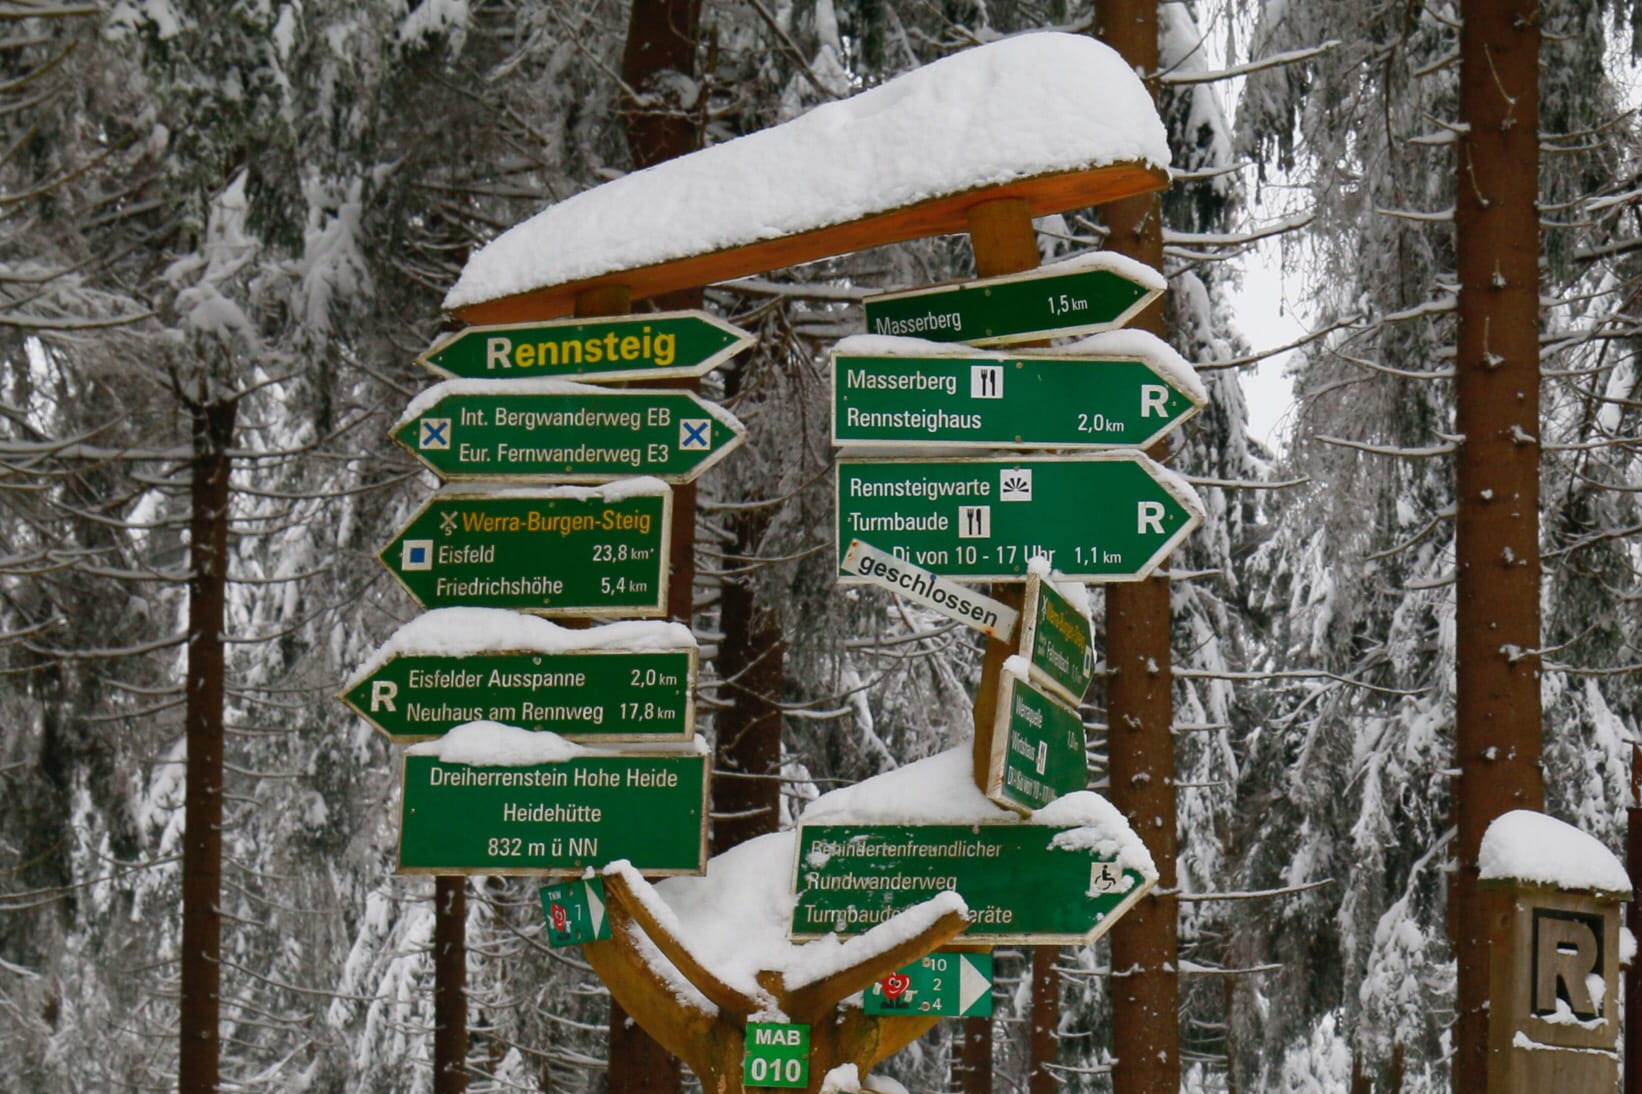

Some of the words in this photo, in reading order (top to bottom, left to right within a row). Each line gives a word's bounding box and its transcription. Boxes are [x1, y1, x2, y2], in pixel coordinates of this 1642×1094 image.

[876, 312, 962, 335] Masserberg
[1048, 295, 1069, 314] 1,5
[1072, 298, 1088, 311] km
[486, 326, 676, 369] Rennsteig
[847, 370, 956, 394] Masserberg
[1141, 384, 1170, 418] R
[460, 407, 488, 426] Int.
[496, 407, 640, 430] Bergwanderweg
[648, 408, 670, 426] EB
[847, 408, 982, 433] Rennsteighaus
[1078, 414, 1104, 434] 2,0
[1106, 420, 1124, 432] km
[460, 445, 490, 462] Eur.
[498, 444, 640, 466] Fernwanderweg
[648, 445, 668, 462] E3
[850, 478, 990, 500] Rennsteigwarte
[462, 510, 650, 535] Werra-Burgen-Steig
[850, 512, 948, 531] Turmbaude
[1138, 502, 1165, 534] R
[438, 546, 494, 564] Eisfeld
[592, 544, 628, 562] 23,8
[631, 548, 648, 560] km
[916, 551, 948, 564] von
[956, 546, 976, 564] 10
[996, 546, 1016, 564] 17
[1074, 546, 1097, 565] 1,1
[1104, 551, 1122, 564] km
[436, 576, 563, 596] Friedrichshöhe
[601, 577, 625, 595] 5,4
[629, 580, 646, 592] km
[858, 554, 998, 627] geschlossen
[408, 670, 482, 688] Eisfelder
[488, 670, 585, 691] Ausspanne
[630, 670, 656, 688] 2,0
[660, 674, 676, 684] km
[370, 680, 397, 712] R
[407, 703, 482, 722] Neuhaus
[490, 706, 515, 720] am
[522, 702, 604, 724] Rennweg
[619, 703, 654, 722] 17,8
[658, 707, 675, 718] km
[430, 768, 567, 788] Dreiherrenstein
[574, 768, 620, 786] Hohe
[626, 768, 678, 788] Heide
[504, 803, 601, 822] Heidehütte
[488, 839, 521, 856] 832
[528, 843, 544, 856] m
[551, 838, 562, 856] ü
[568, 839, 598, 856] NN
[808, 872, 957, 891] Rundwanderweg
[574, 904, 582, 920] 1
[931, 958, 947, 972] 10
[1537, 916, 1599, 1014] R
[932, 978, 942, 991] 2
[932, 998, 942, 1010] 4
[756, 1030, 800, 1046] MAB
[752, 1058, 802, 1082] 010
